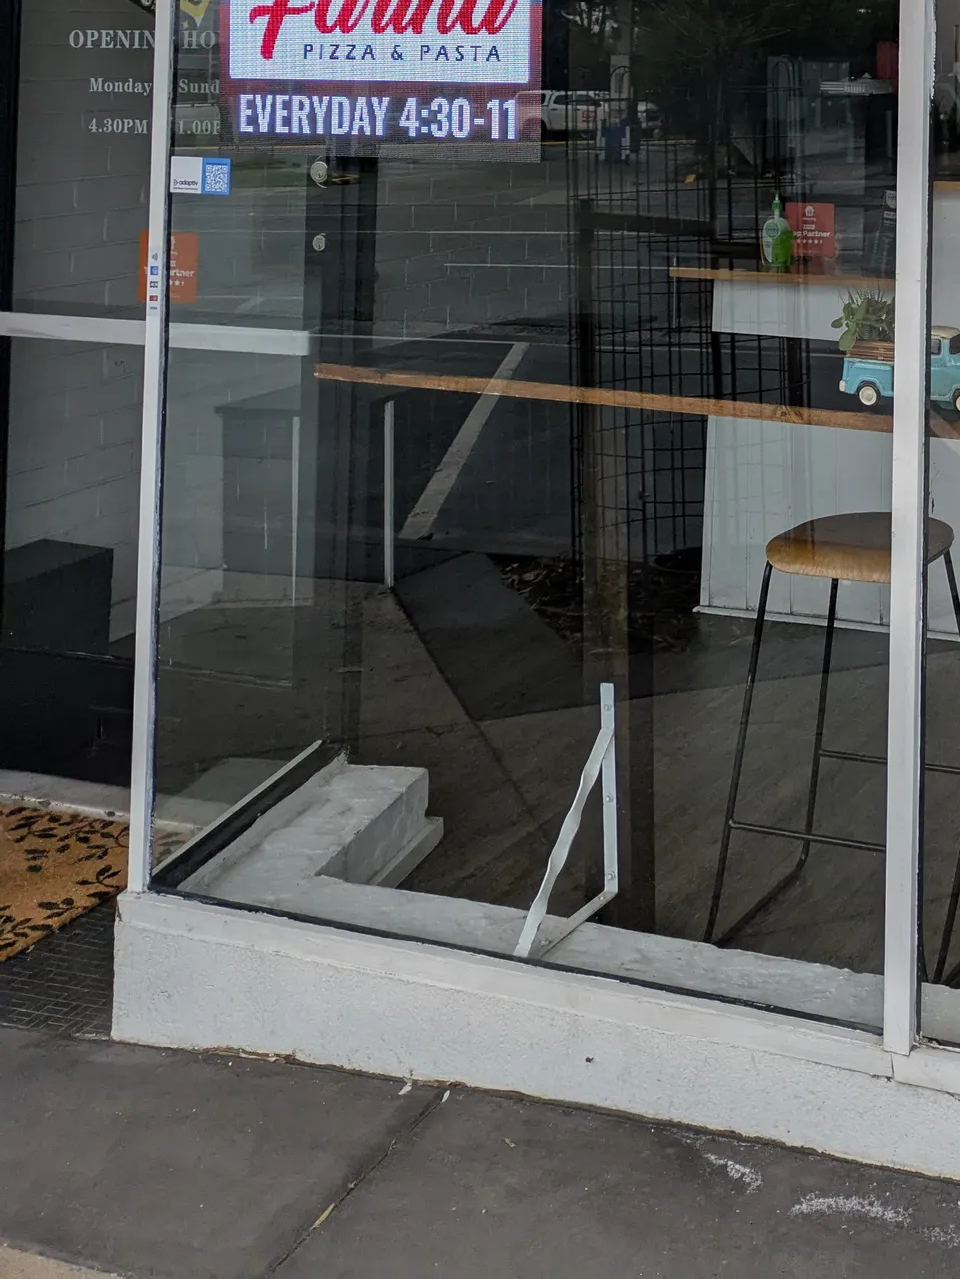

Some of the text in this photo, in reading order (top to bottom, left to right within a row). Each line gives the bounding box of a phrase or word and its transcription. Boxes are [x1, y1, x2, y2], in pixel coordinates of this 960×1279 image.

[69, 29, 156, 49] OPENIN
[304, 43, 500, 62] PIZZA & PASTA
[89, 78, 220, 95] Monday Sund
[89, 118, 148, 134] 4.30PM
[239, 94, 517, 140] EVERYDAY 4:30-11
[803, 230, 830, 238] Partner
